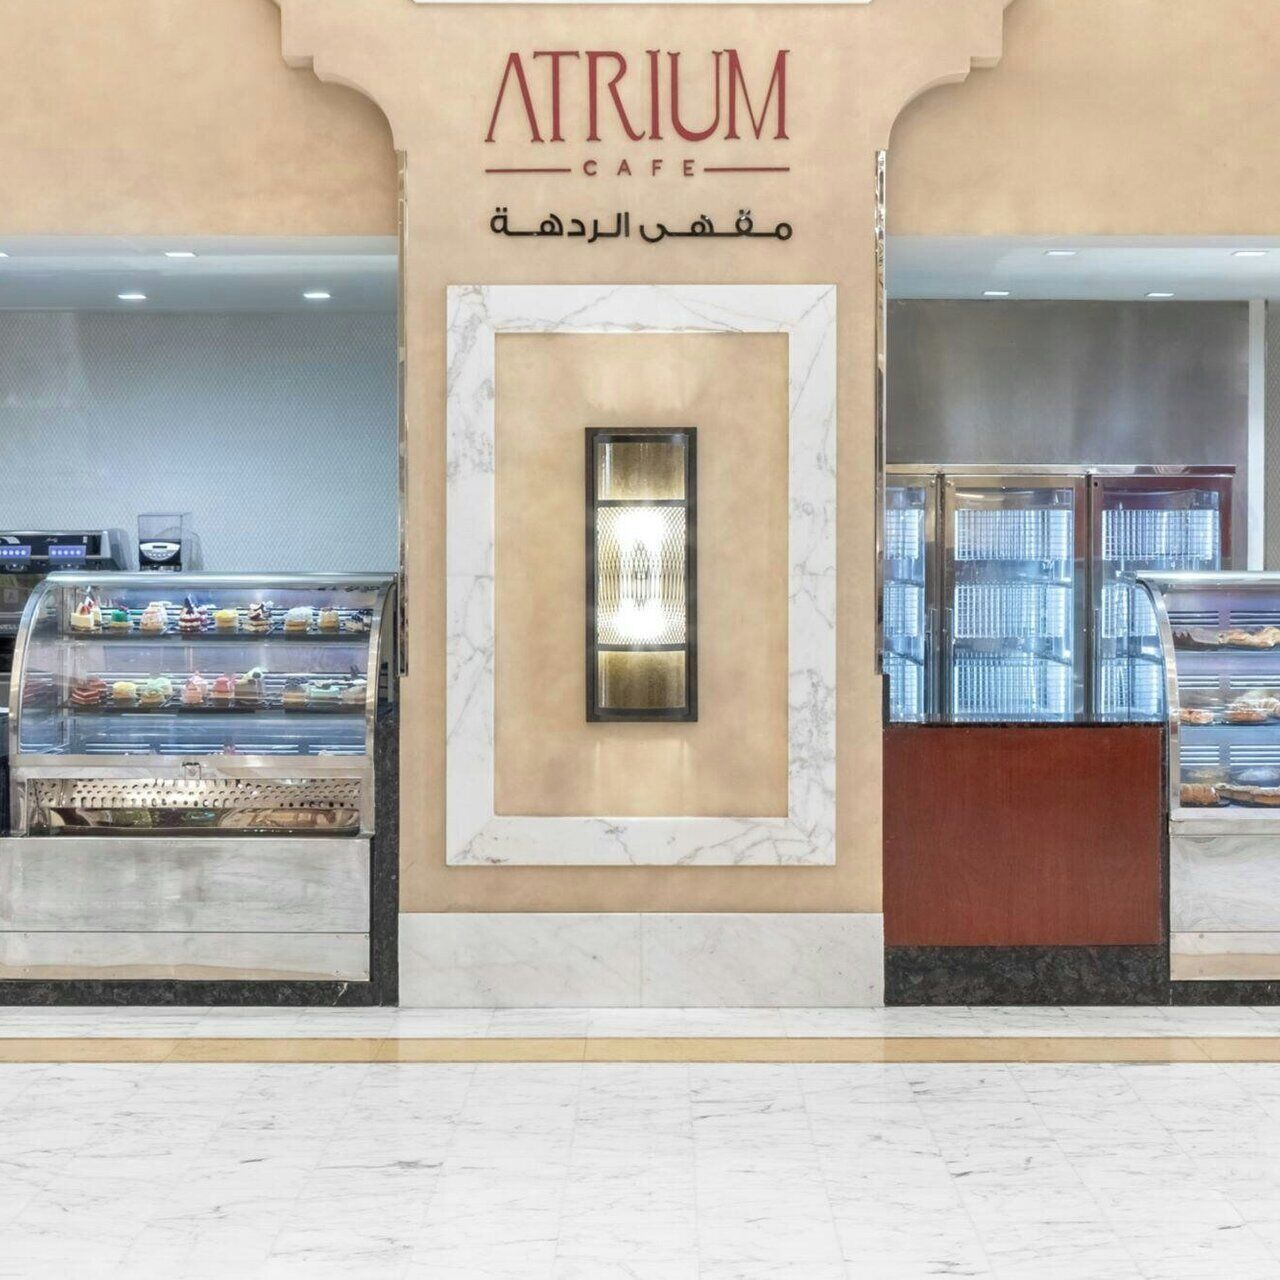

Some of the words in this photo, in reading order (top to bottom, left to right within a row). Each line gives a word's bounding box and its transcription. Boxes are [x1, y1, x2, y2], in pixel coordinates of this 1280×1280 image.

[485, 49, 790, 143] ATRIUM
[583, 159, 695, 177] CAFE
[490, 207, 630, 244] الردهة
[640, 209, 793, 244] مقهى
